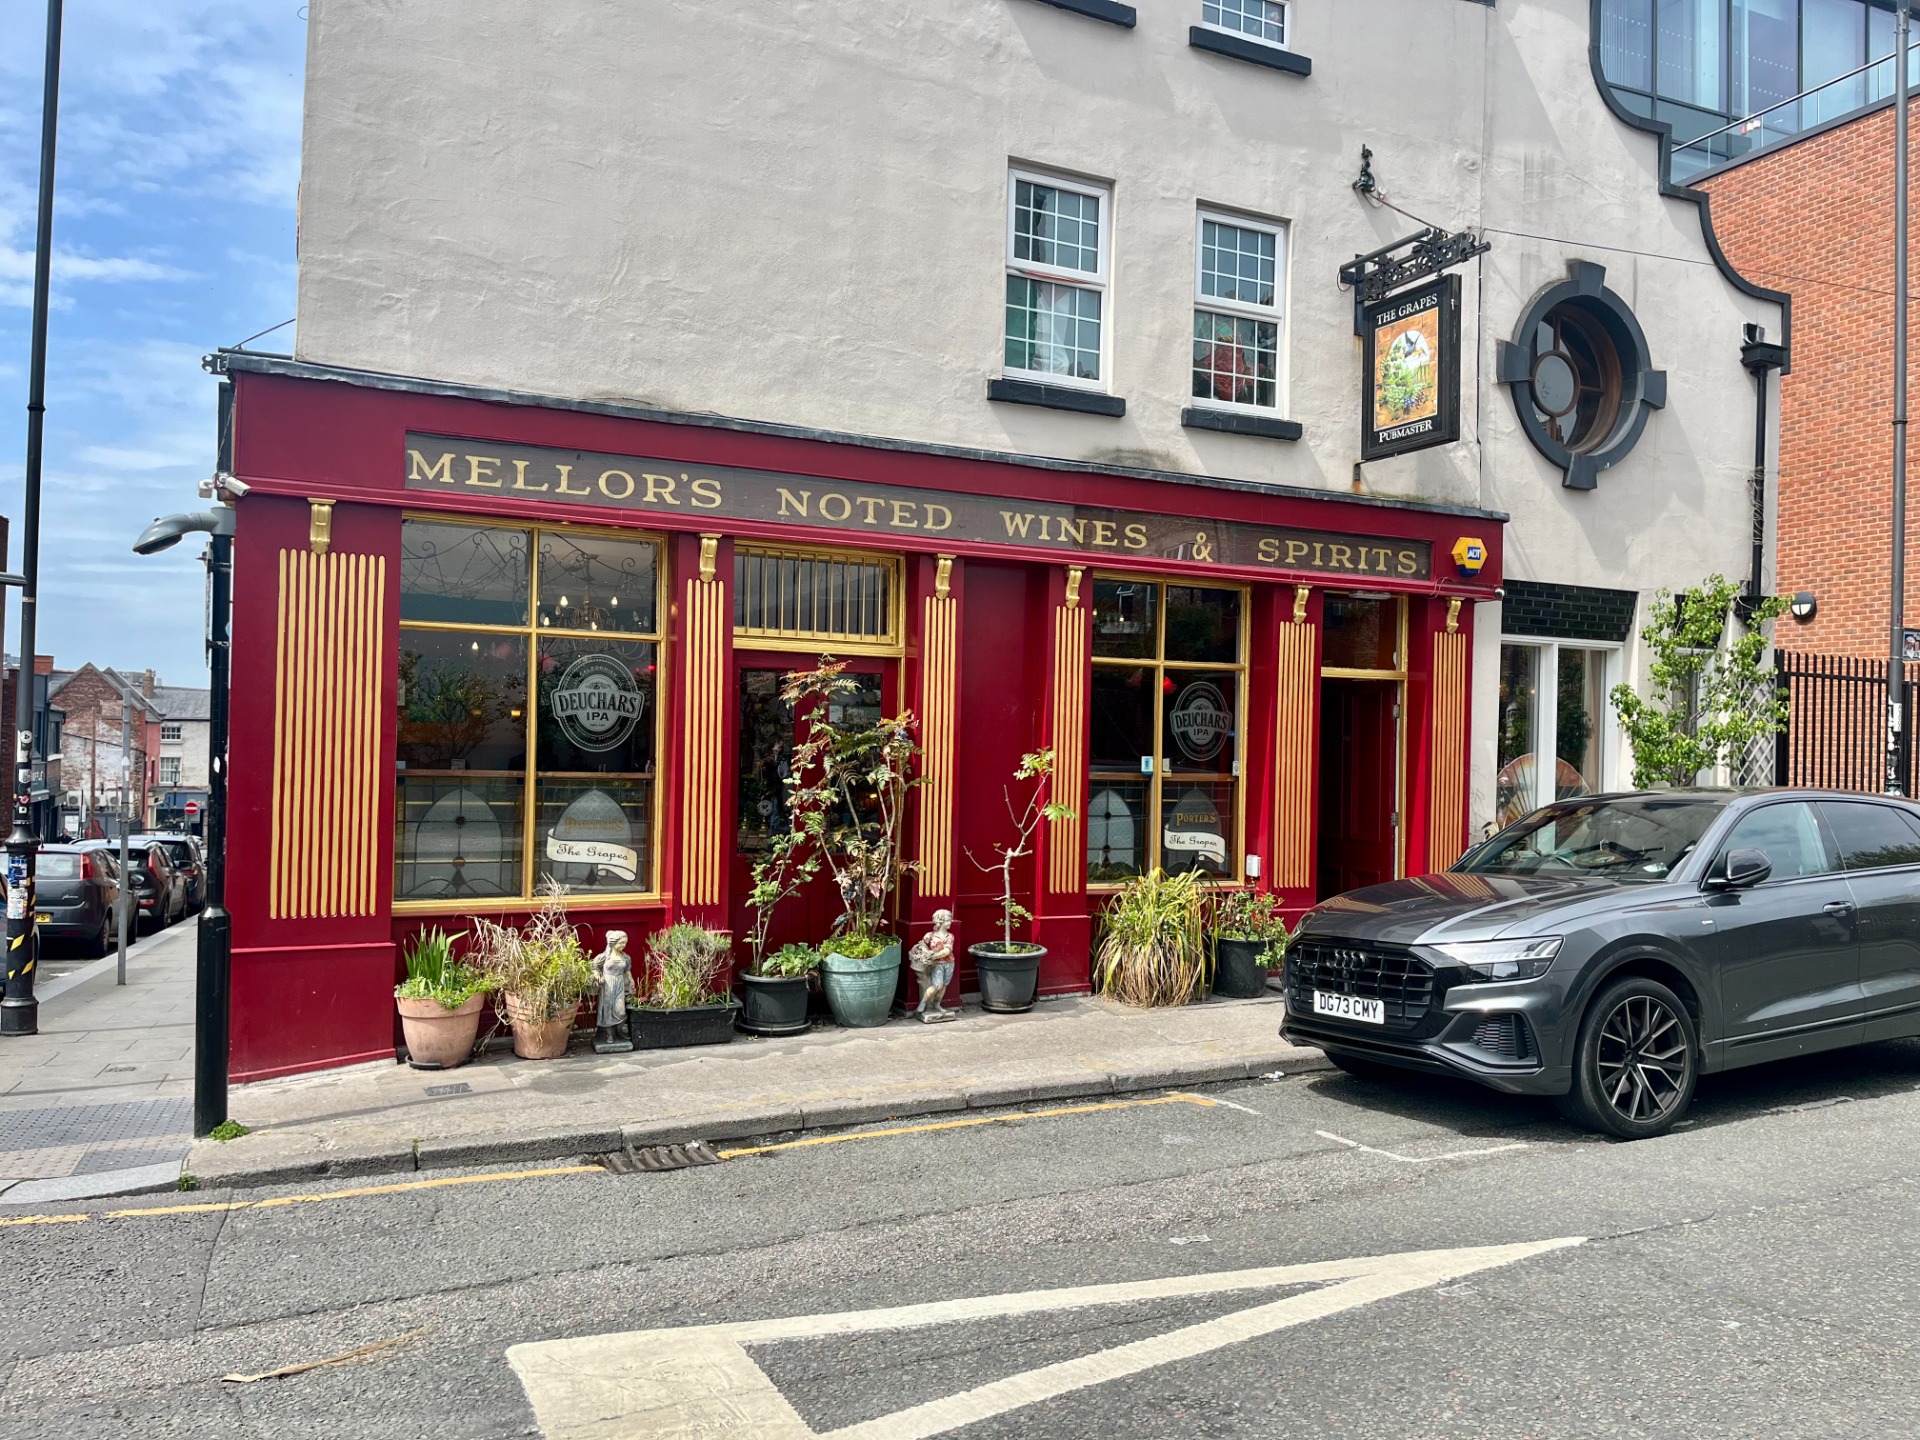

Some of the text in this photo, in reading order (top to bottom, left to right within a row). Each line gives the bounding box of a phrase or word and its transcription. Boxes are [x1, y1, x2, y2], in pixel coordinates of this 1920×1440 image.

[1376, 293, 1438, 325] THE GRAPES
[407, 450, 723, 508] MELLOR'S
[776, 488, 953, 531] NOTED
[1000, 511, 1148, 549] WINES
[1192, 532, 1213, 563] &
[1467, 548, 1481, 559] ADT
[558, 691, 637, 714] DEUCHARS
[586, 711, 610, 722] IPA
[1175, 711, 1228, 730] DEUCHARS
[1193, 728, 1209, 736] IPA
[1168, 834, 1218, 848] The Grapes
[556, 843, 629, 862] The Grapes
[1319, 993, 1379, 1019] DG73 CMY
